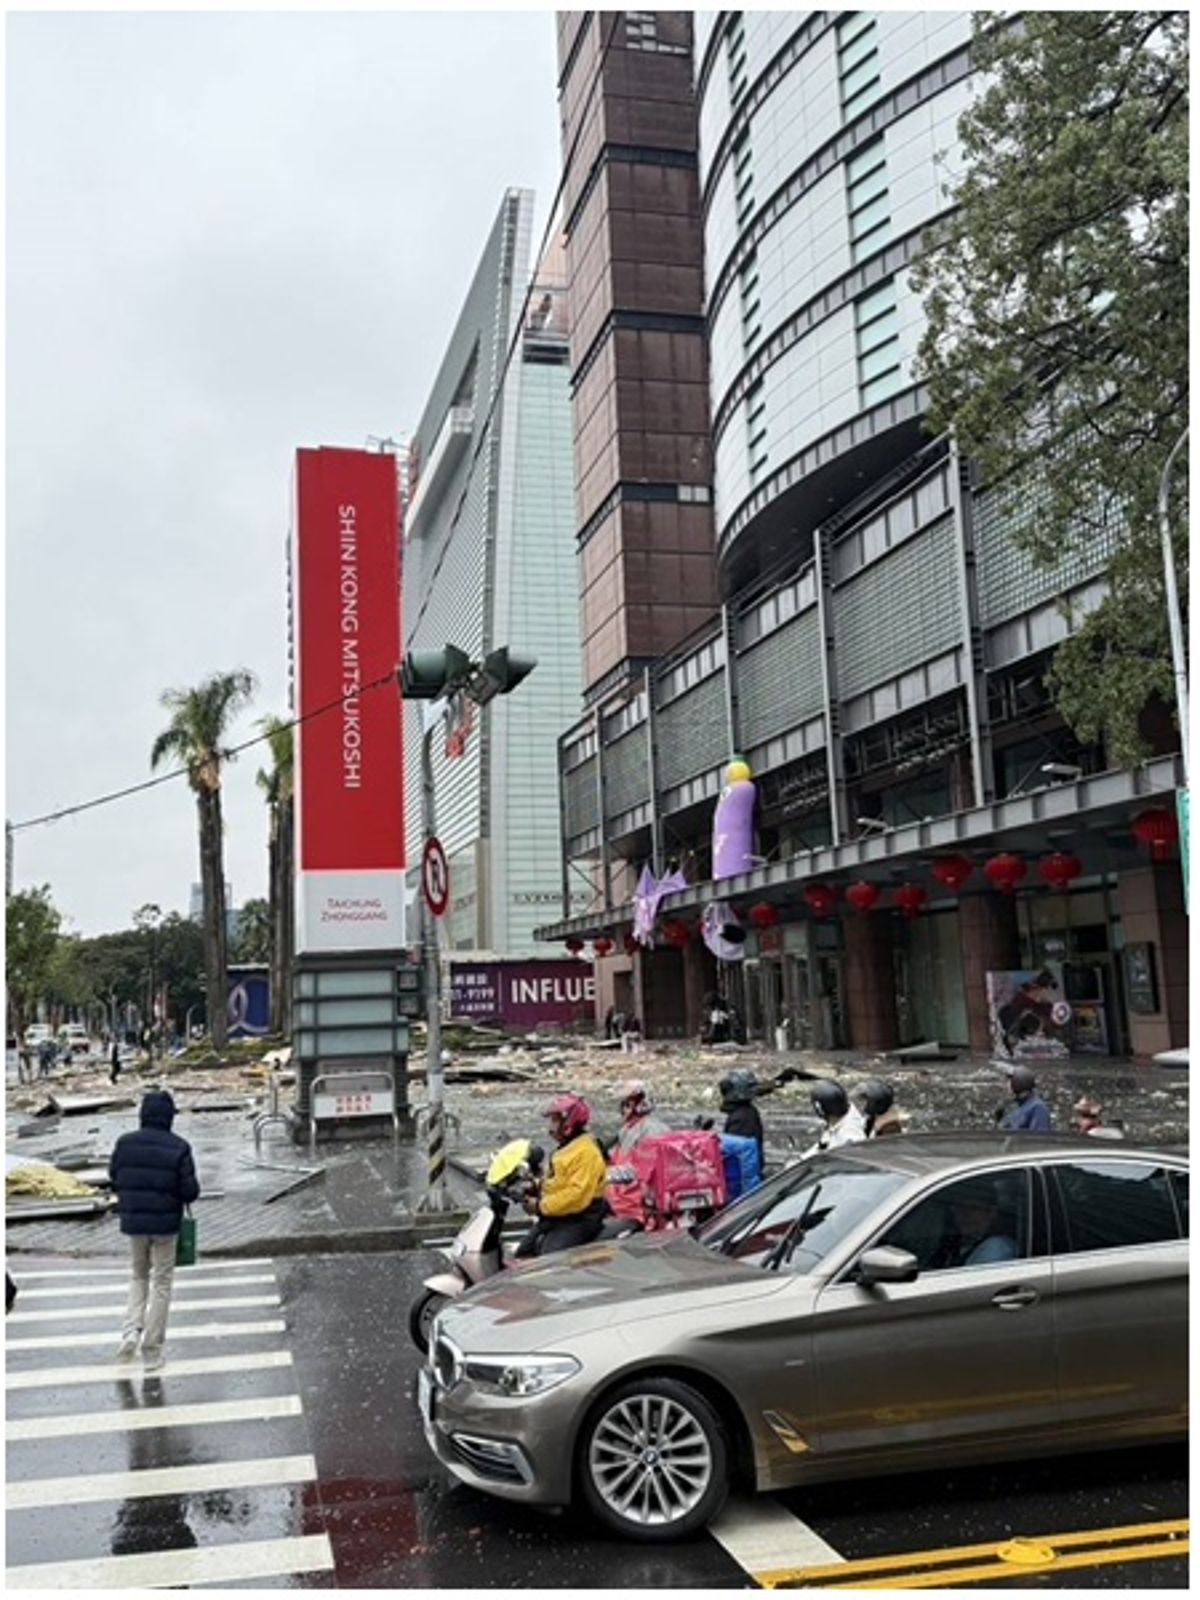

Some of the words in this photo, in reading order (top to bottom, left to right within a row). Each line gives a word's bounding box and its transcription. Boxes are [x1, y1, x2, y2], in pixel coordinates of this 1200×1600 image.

[337, 504, 356, 562] SHIN
[338, 564, 360, 633] KONG
[341, 638, 362, 789] MITSUKOSHI
[320, 909, 389, 923] ZHONGGANG
[327, 897, 382, 910] TAICHUNG
[510, 977, 596, 1004] INFLUE
